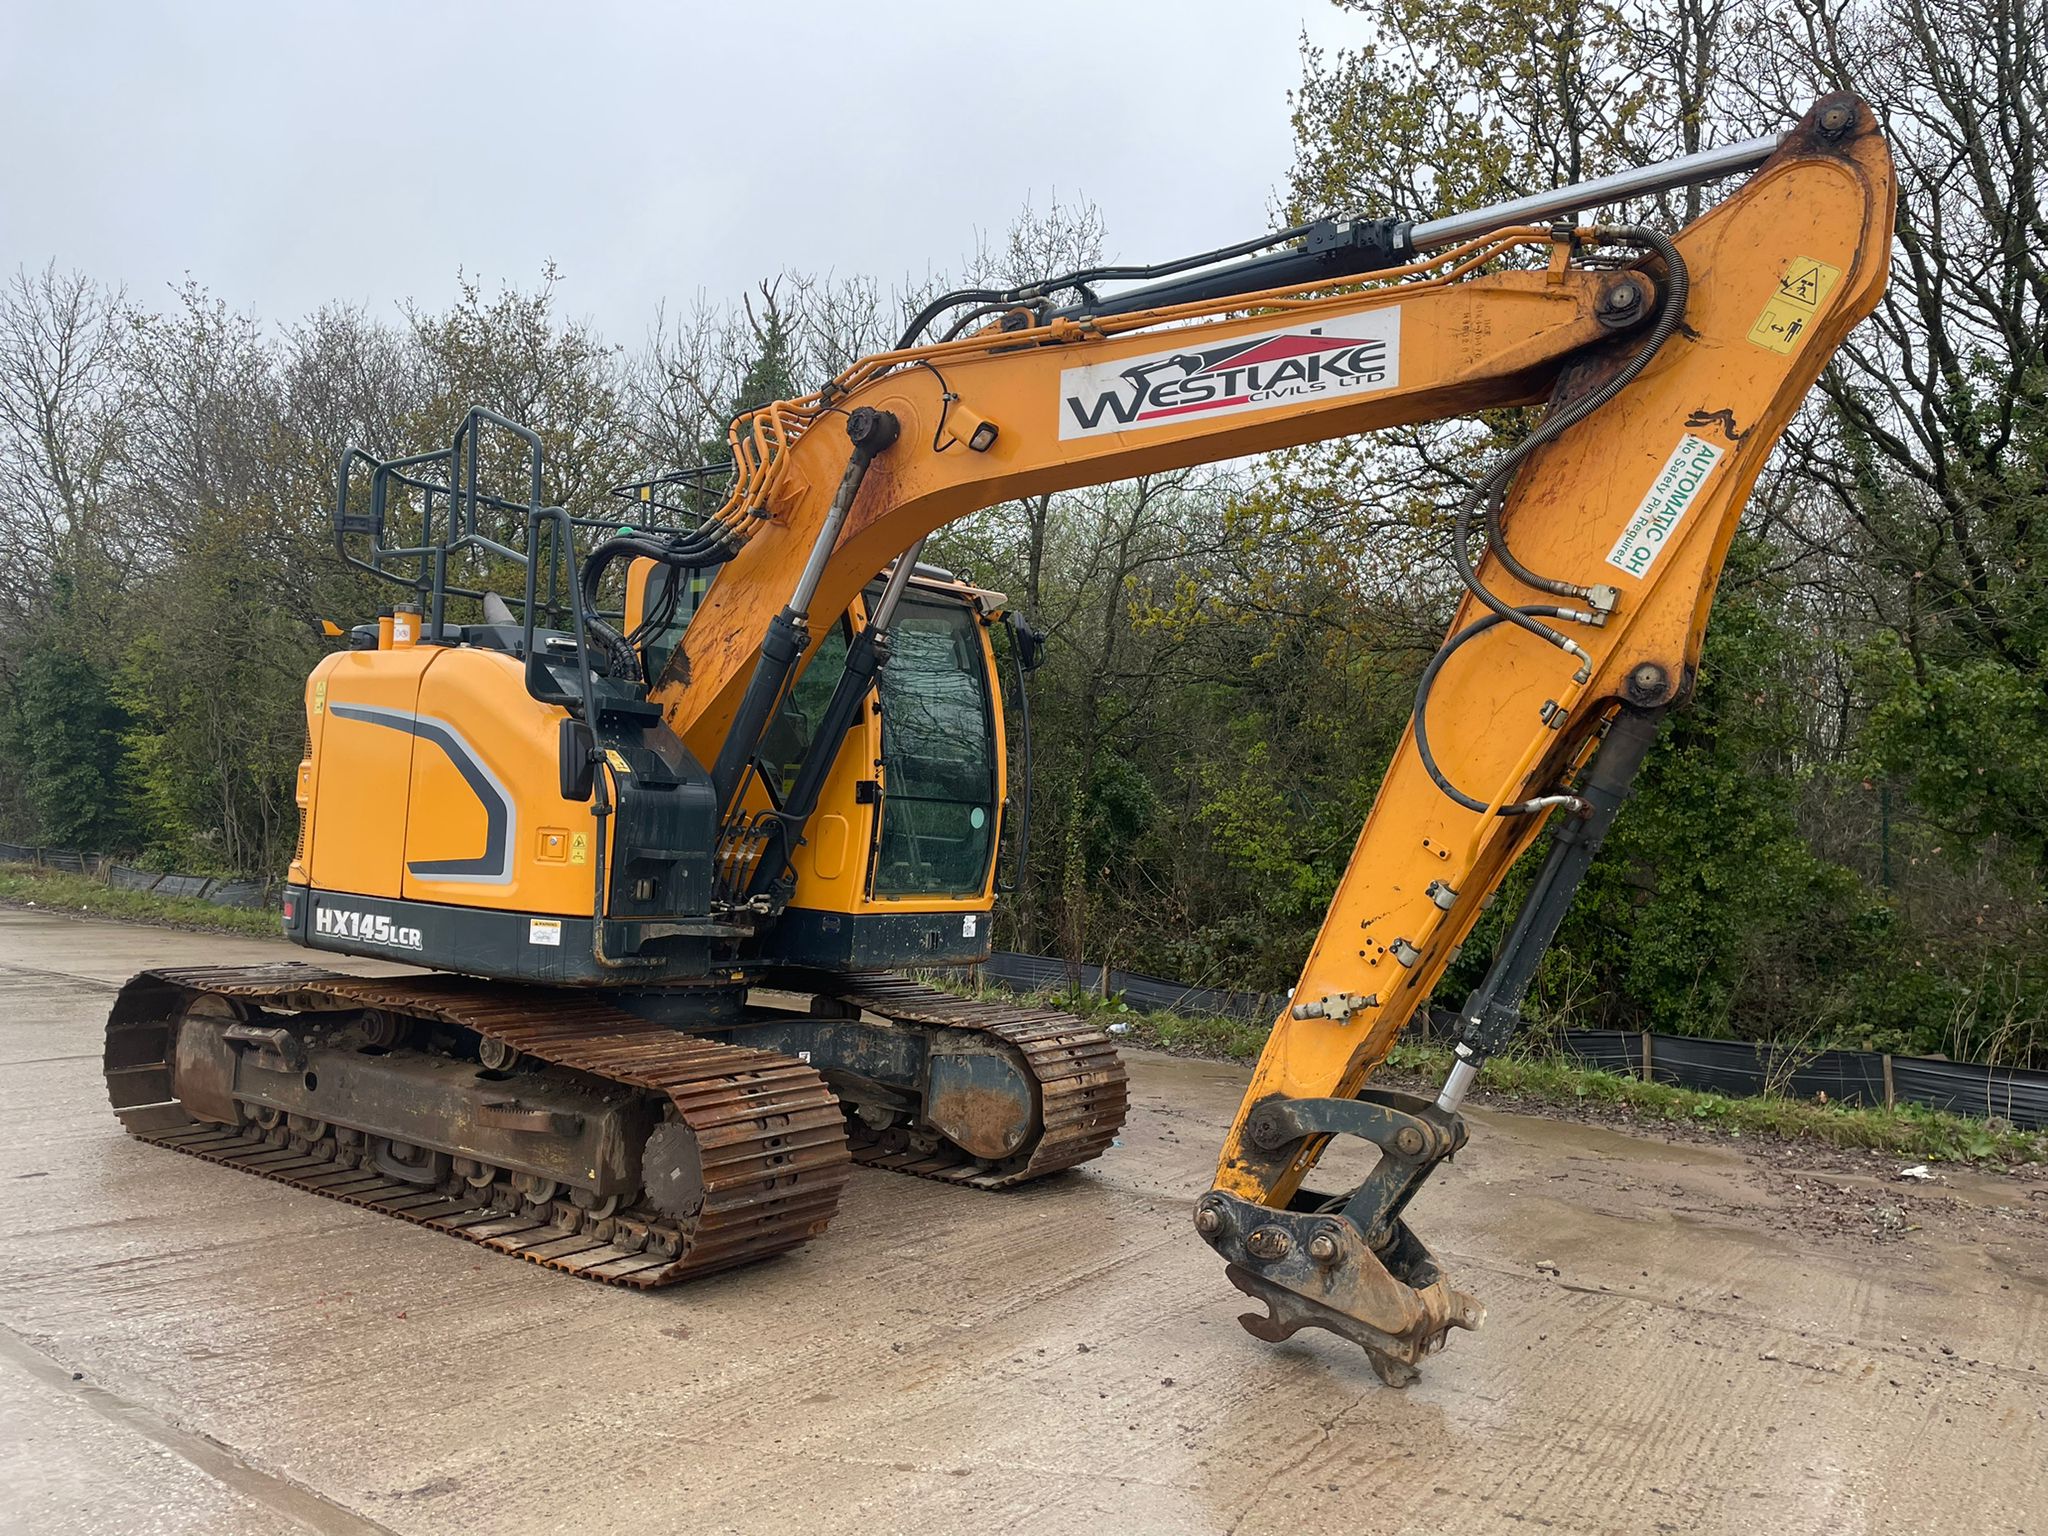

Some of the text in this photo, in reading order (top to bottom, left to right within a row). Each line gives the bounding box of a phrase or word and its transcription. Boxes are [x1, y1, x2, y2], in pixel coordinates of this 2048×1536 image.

[1066, 342, 1386, 430] WESTLAKE
[1248, 372, 1385, 403] CIVILS LTD
[1612, 439, 1699, 565] No Safety Pin Required
[1625, 445, 1715, 574] AUTOMATIC QH
